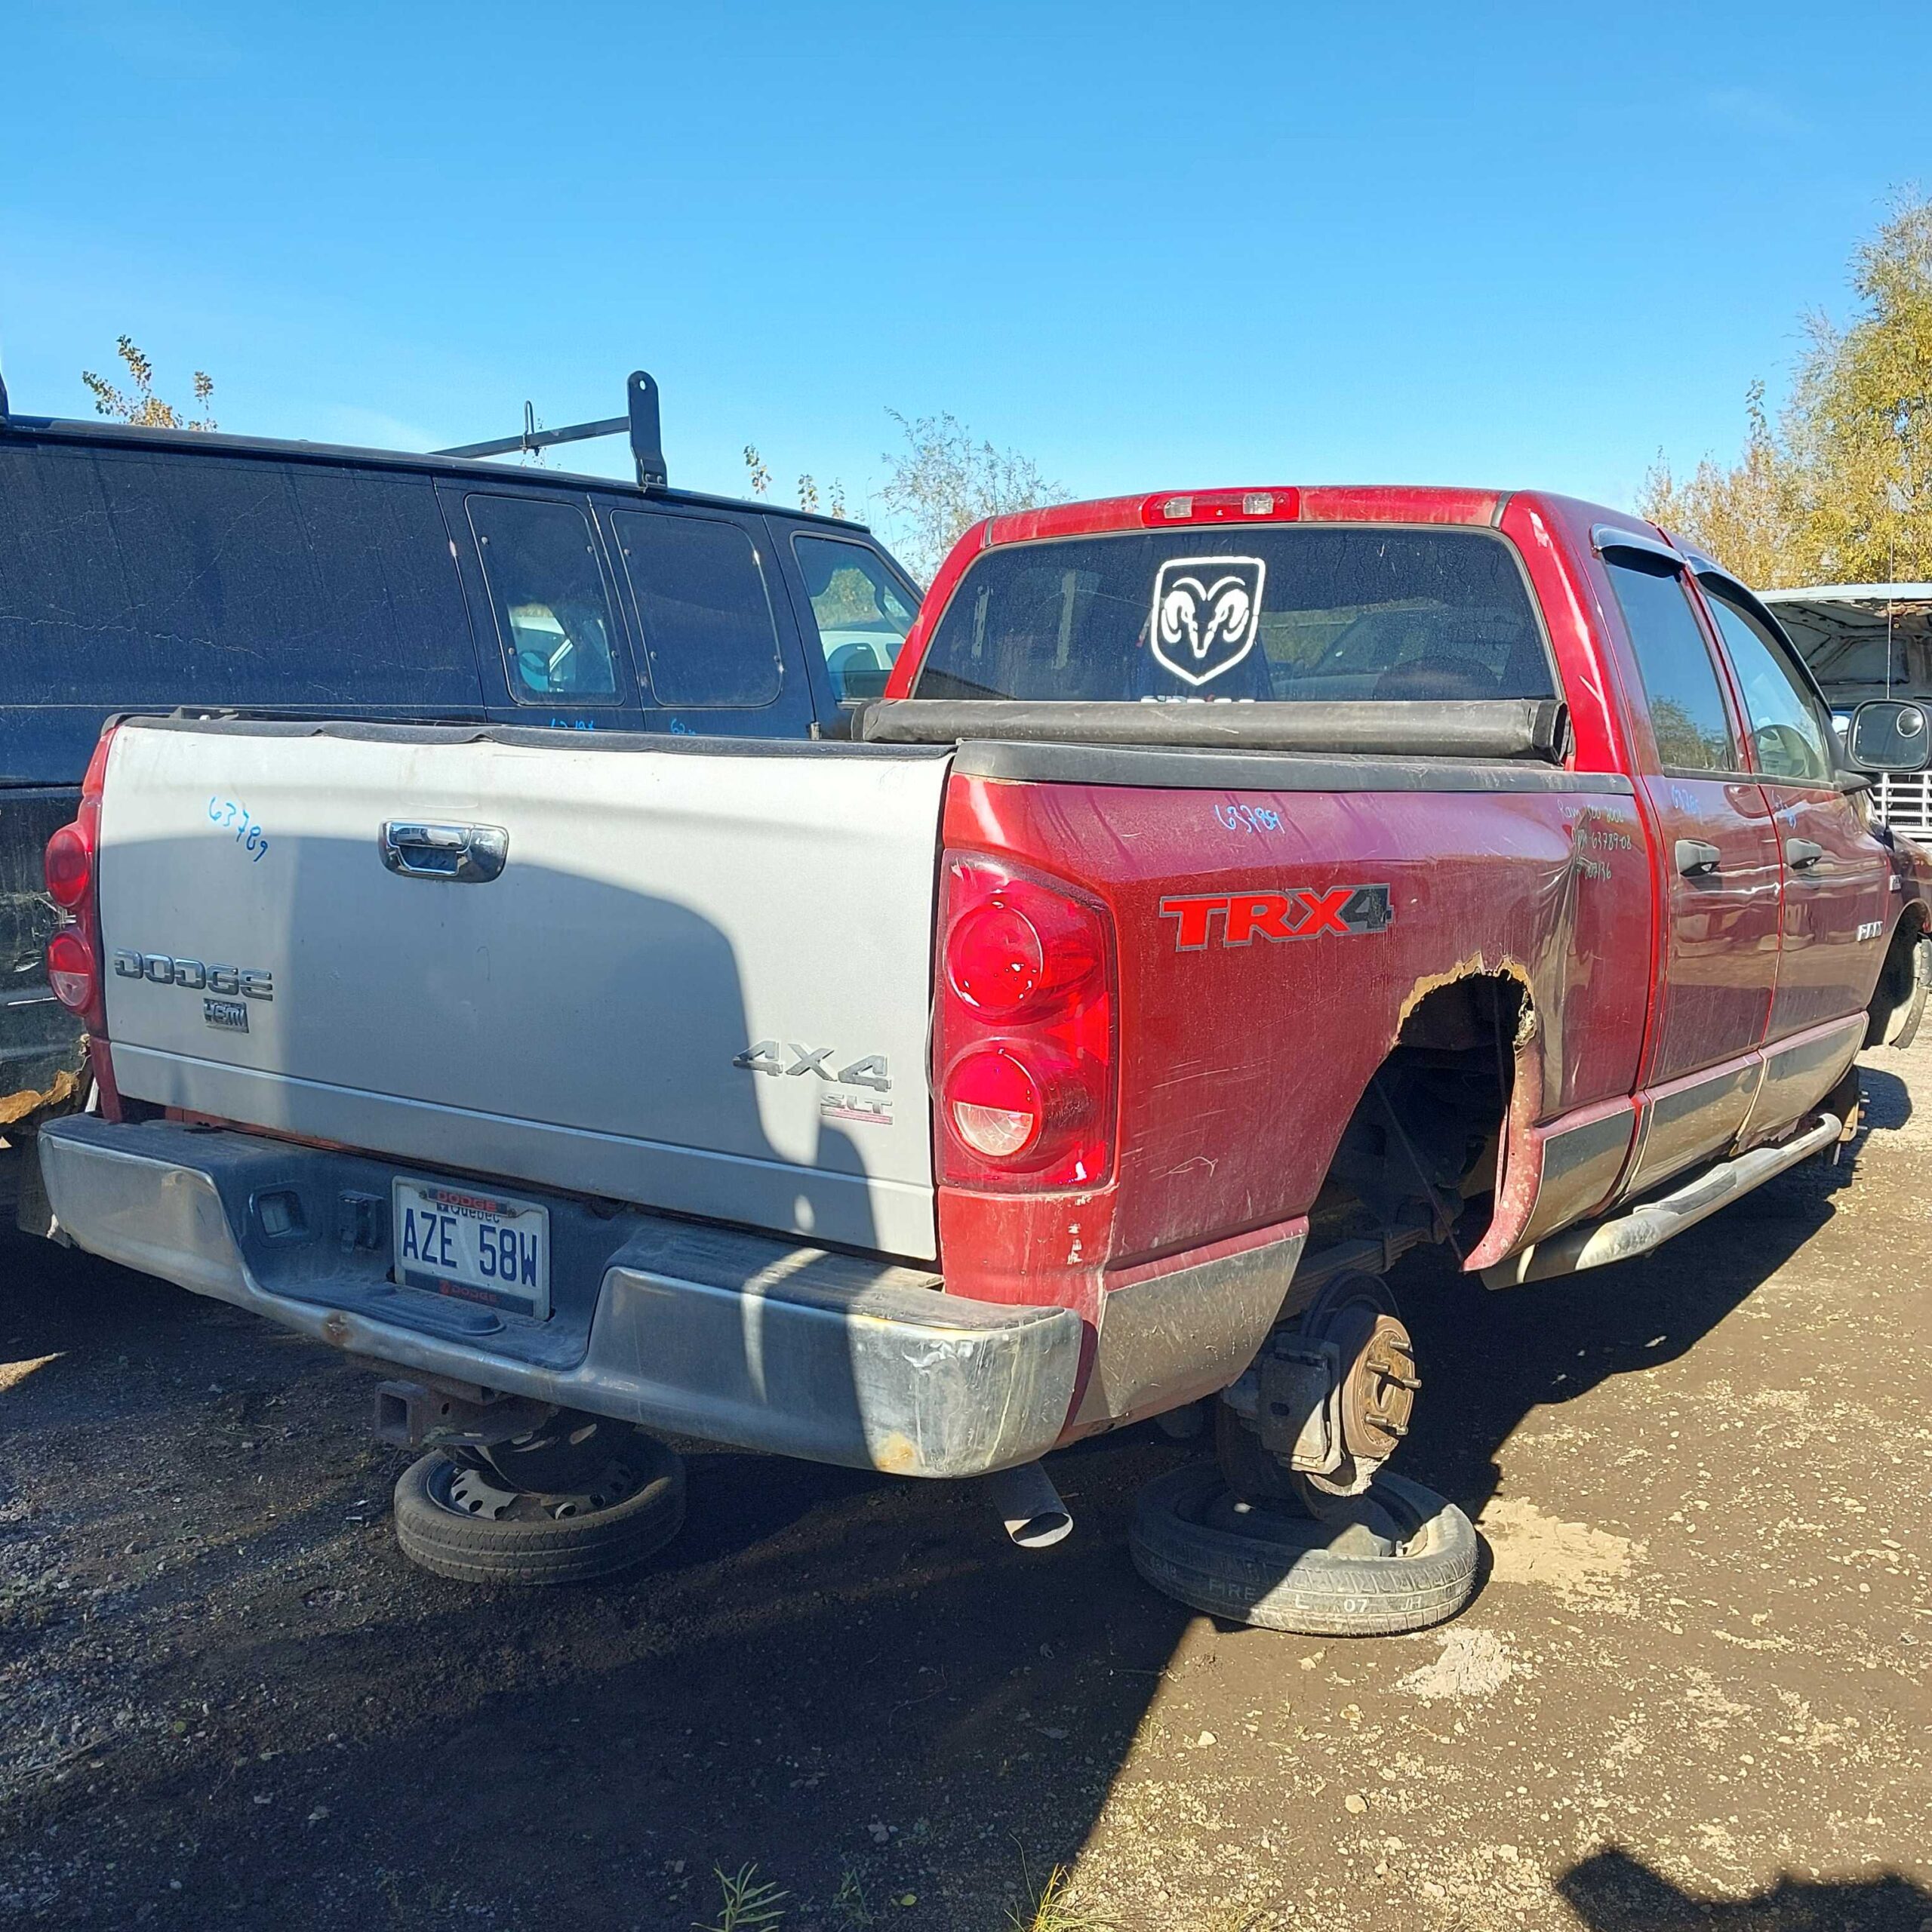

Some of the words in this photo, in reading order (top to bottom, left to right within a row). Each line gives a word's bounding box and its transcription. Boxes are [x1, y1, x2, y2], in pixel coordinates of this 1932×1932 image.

[209, 796, 268, 862] 63789
[1214, 804, 1285, 834] 63789
[1159, 883, 1394, 952] TRX4
[114, 949, 273, 1001] DODGE
[821, 1094, 892, 1115] SLT
[437, 1190, 497, 1211] DODGE
[403, 1208, 457, 1269] AZE
[478, 1223, 537, 1287] 58W
